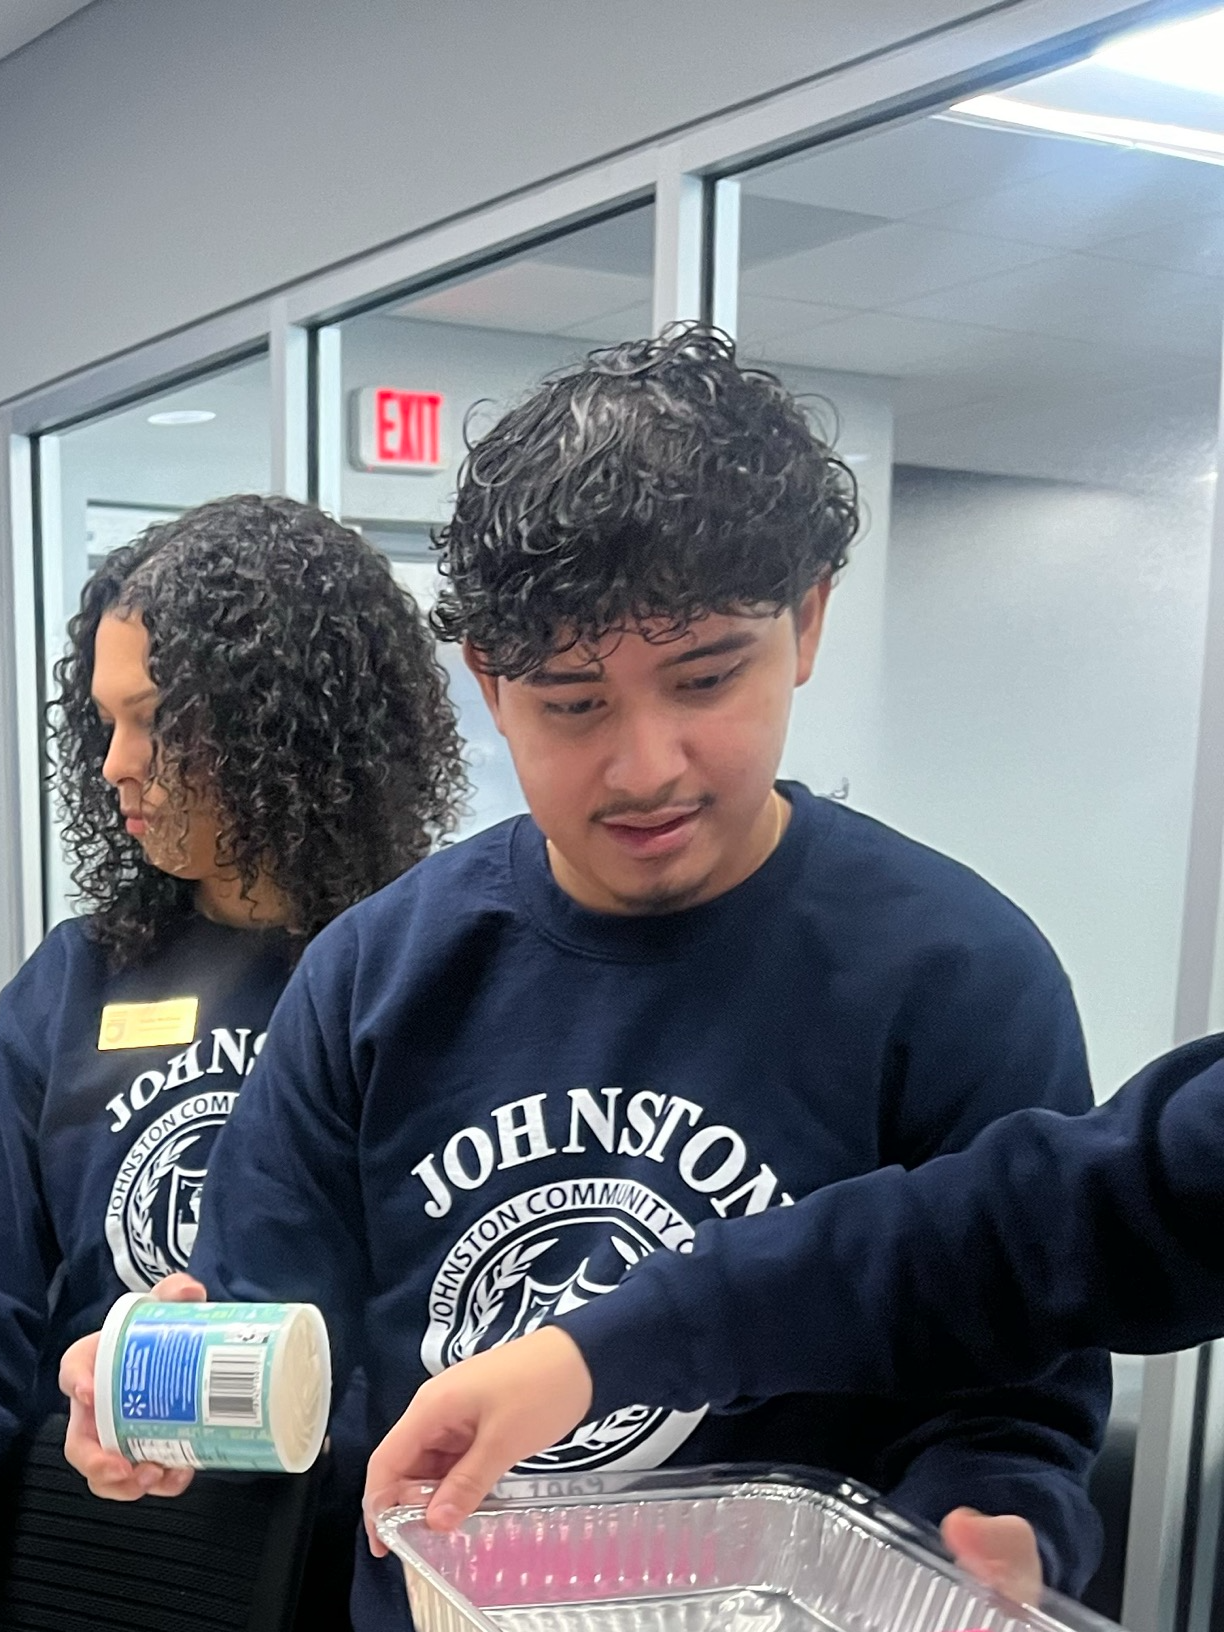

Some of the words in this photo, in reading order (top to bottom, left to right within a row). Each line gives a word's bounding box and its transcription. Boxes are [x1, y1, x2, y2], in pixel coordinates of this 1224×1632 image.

[378, 391, 443, 463] EXIT
[109, 1117, 177, 1221] JOHNSTON
[411, 1087, 795, 1218] JOHNSTON
[432, 1204, 520, 1330] JOHNSTON
[527, 1182, 683, 1236] COMMUNITY
